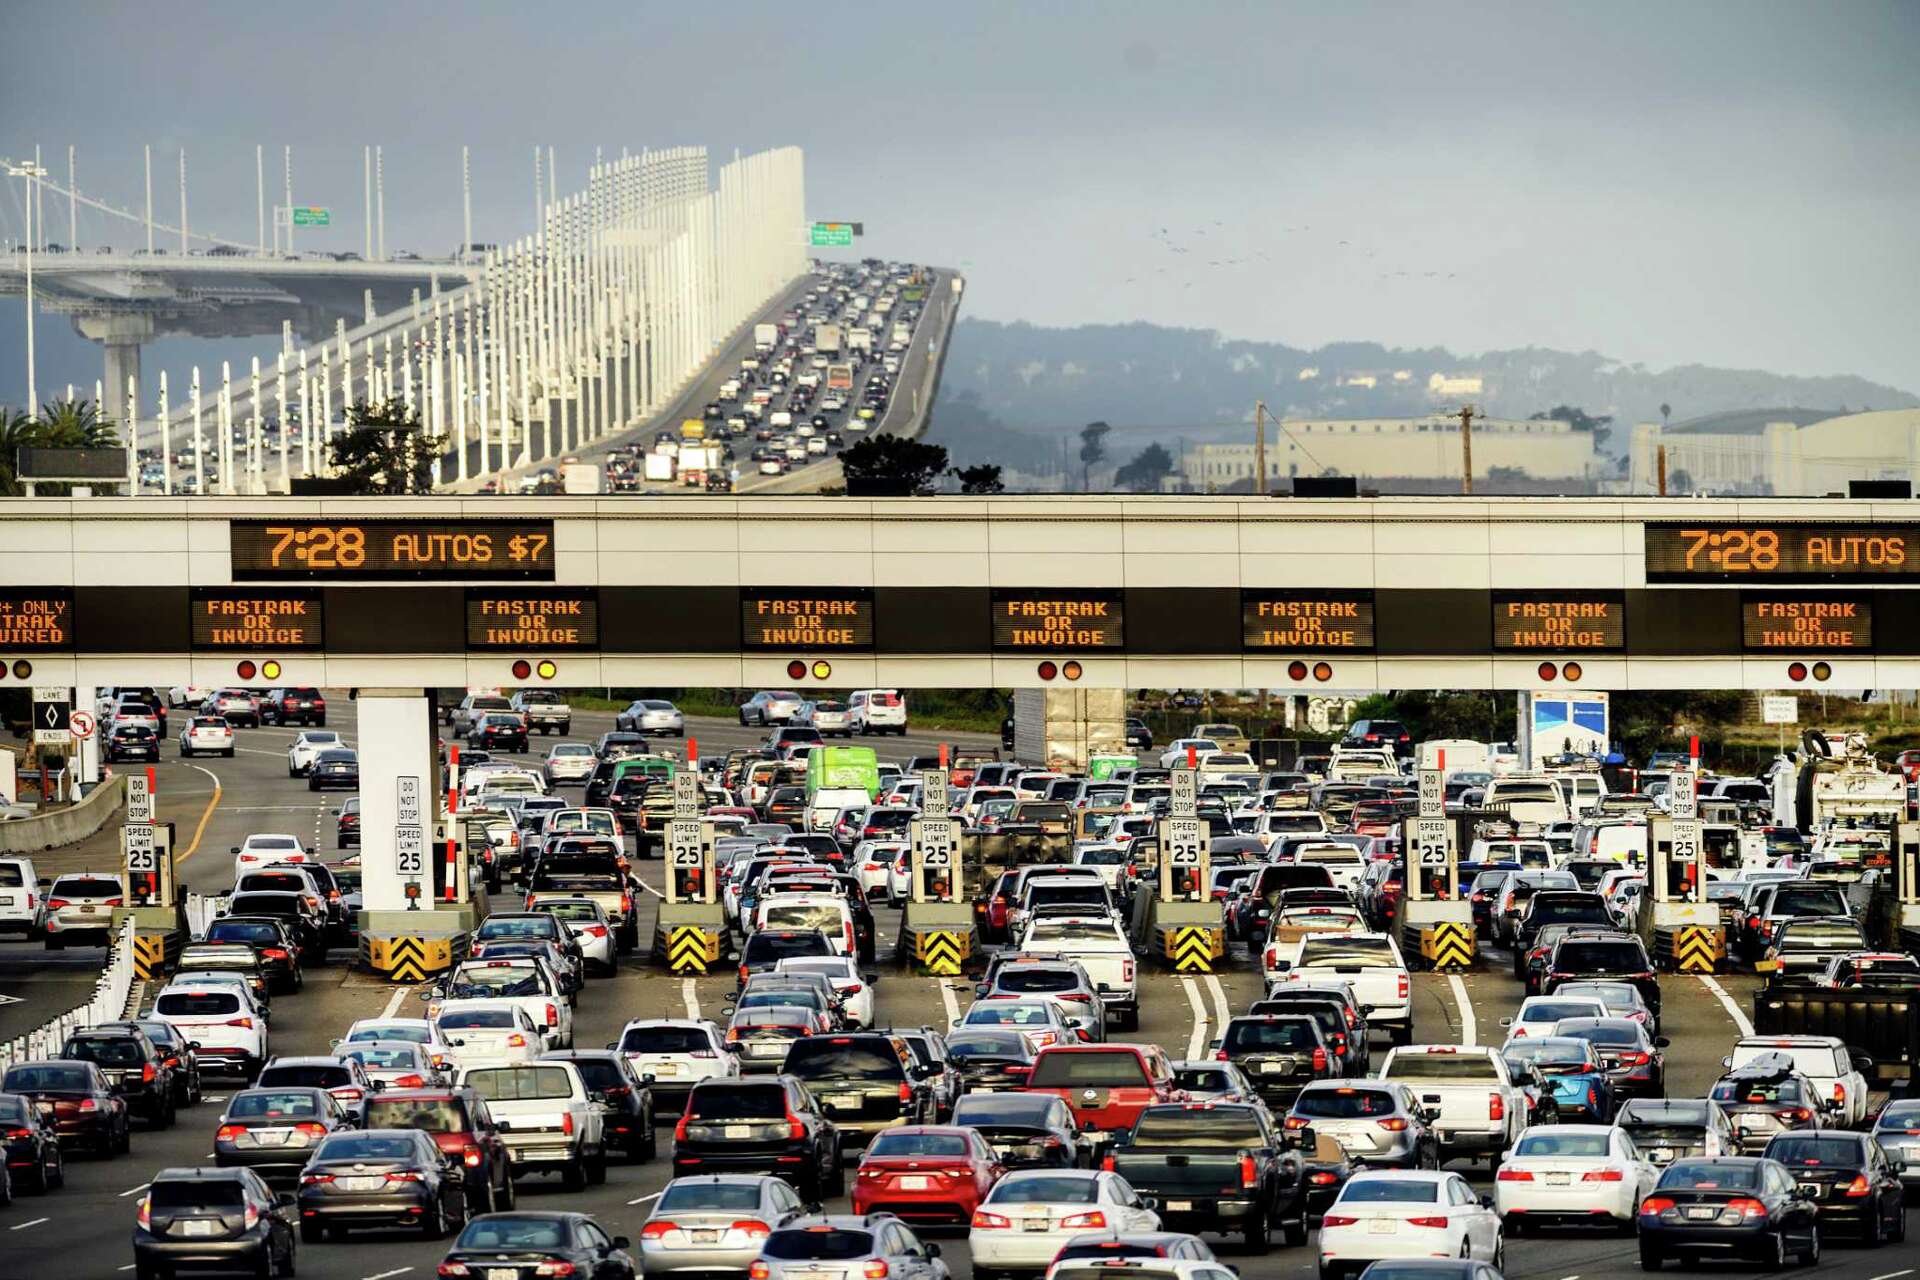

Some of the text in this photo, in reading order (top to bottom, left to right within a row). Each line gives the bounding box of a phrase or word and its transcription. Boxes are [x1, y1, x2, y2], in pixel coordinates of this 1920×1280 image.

[267, 528, 547, 566] 7:28 AUTOS $7
[1680, 530, 1904, 569] 7:28 AUTOS
[23, 601, 65, 614] ONLY
[208, 601, 304, 614] FASTRAK
[483, 601, 579, 613] FASTRAK
[759, 601, 855, 614] FASTRAK
[1009, 602, 1105, 615] FASTRAK
[1260, 603, 1356, 616] FASTRAK
[1509, 604, 1606, 616] FASTRAK
[1759, 604, 1854, 616] FASTRAK
[244, 615, 270, 628] OR
[519, 616, 545, 628] OR
[795, 616, 821, 628] OR
[1045, 617, 1071, 630] OR
[1295, 615, 1321, 630] OR
[1546, 618, 1571, 631] OR
[1795, 618, 1820, 631] OR
[214, 629, 302, 642] INVOICE
[489, 630, 576, 642] INVOICE
[764, 630, 852, 643] INVOICE
[1014, 630, 1103, 644] INVOICE
[1264, 630, 1353, 645] INVOICE
[1514, 631, 1603, 645] INVOICE
[1763, 631, 1851, 645] INVOICE
[680, 776, 692, 786] DO
[928, 776, 940, 786] DO
[1178, 774, 1188, 784] DO
[1424, 774, 1436, 784] DO
[1676, 776, 1688, 786] DO
[132, 780, 144, 790] DO
[404, 782, 412, 792] DO
[678, 790, 694, 800] NOT
[926, 790, 942, 800] NOT
[1176, 788, 1192, 798] NOT
[1422, 788, 1438, 798] NOT
[1674, 790, 1690, 800] NOT
[130, 794, 146, 804] NOT
[400, 796, 416, 806] NOT
[676, 804, 696, 814] STOP
[926, 804, 946, 812] STOP
[1174, 802, 1194, 812] STOP
[1422, 802, 1440, 812] STOP
[1674, 804, 1694, 814] STOP
[130, 808, 148, 818] STOP
[400, 810, 418, 820] STOP
[674, 824, 700, 834] SPEED
[924, 824, 948, 834] SPEED
[1172, 822, 1198, 832] SPEED
[1420, 822, 1444, 832] SPEED
[1674, 824, 1694, 834] SPEED
[128, 828, 152, 838] SPEED
[398, 830, 420, 840] SPEED
[1174, 834, 1196, 842] LIMIT
[1422, 834, 1442, 842] LIMIT
[130, 838, 150, 848] LIMIT
[676, 836, 696, 844] LIMIT
[926, 834, 946, 844] LIMIT
[400, 842, 418, 850] LIMIT
[1674, 842, 1694, 856] 25
[676, 846, 698, 864] 25
[926, 846, 948, 864] 25
[1174, 844, 1198, 862] 25
[1422, 844, 1446, 864] 25
[130, 850, 152, 868] 25
[400, 852, 420, 870] 25
